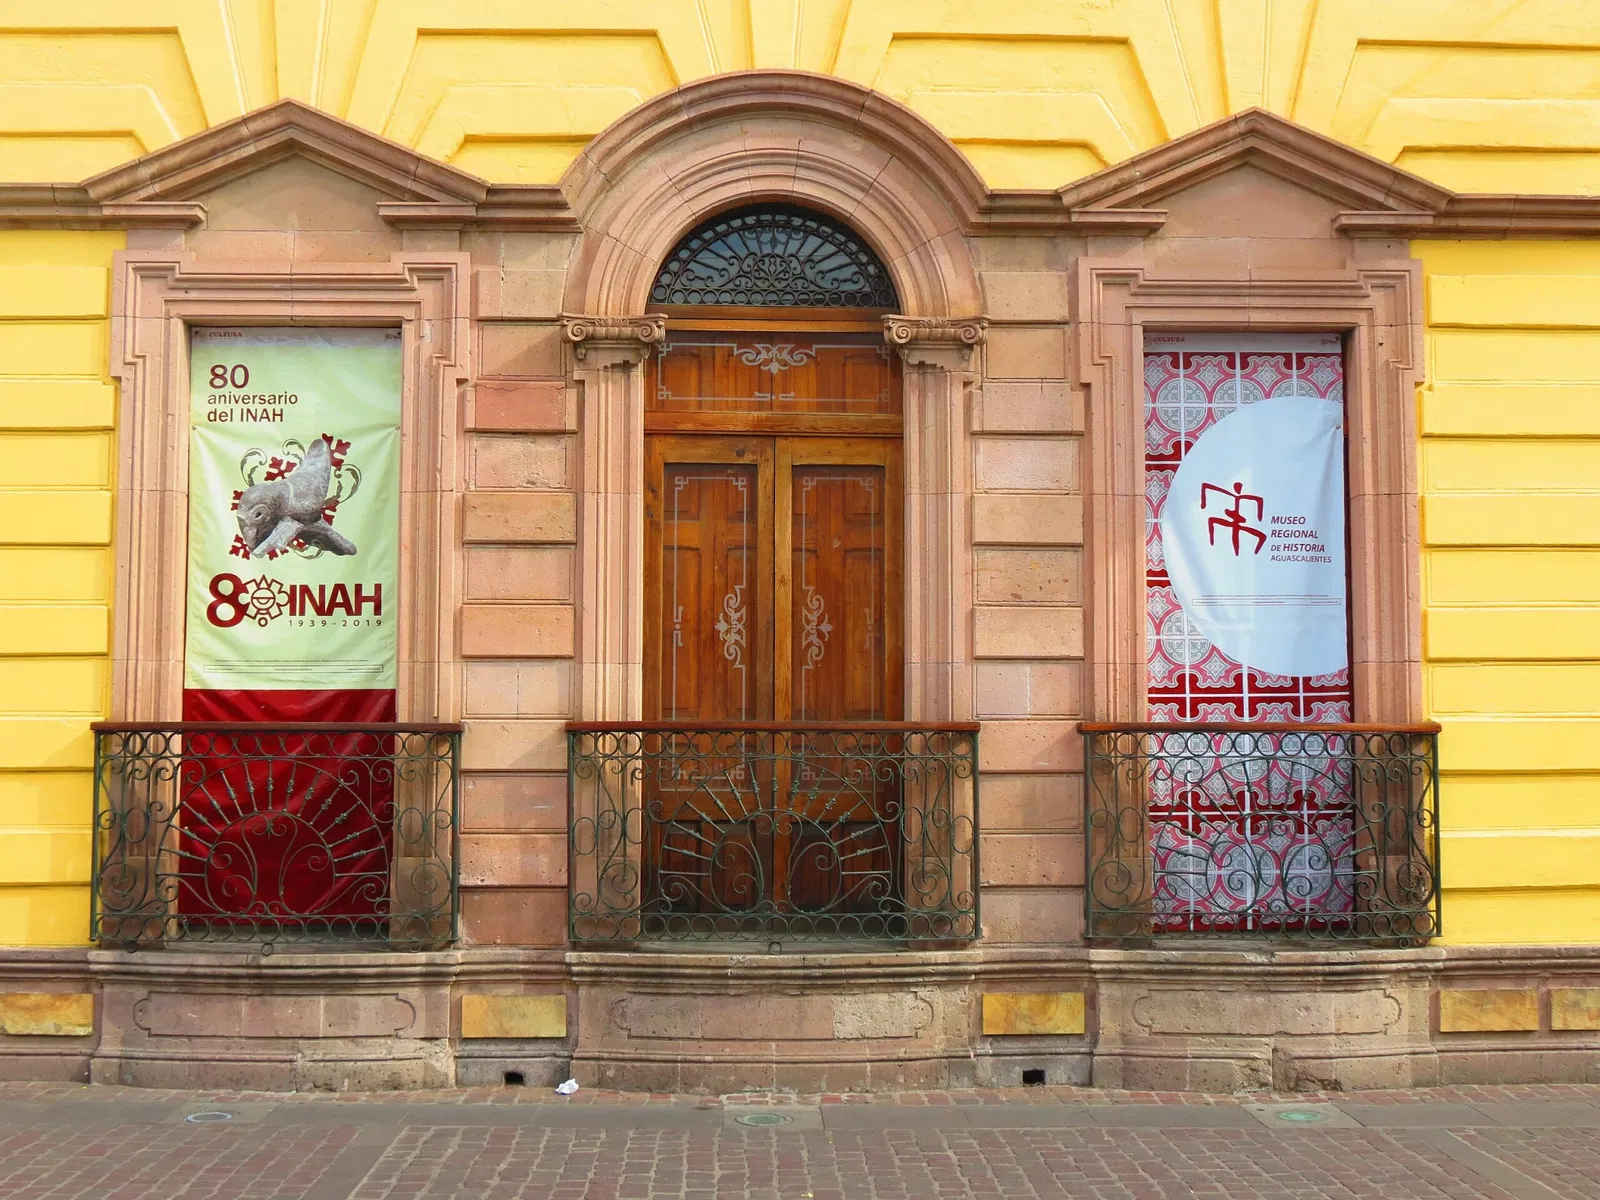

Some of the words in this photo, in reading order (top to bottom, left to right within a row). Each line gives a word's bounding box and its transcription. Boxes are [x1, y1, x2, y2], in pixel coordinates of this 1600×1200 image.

[208, 363, 250, 389] 80
[207, 391, 299, 405] aniversario
[207, 407, 234, 423] del
[240, 407, 284, 423] INAH
[1270, 515, 1306, 525] MUSEO
[1270, 529, 1319, 539] REGIONAL
[1270, 544, 1281, 552] DE
[1283, 543, 1325, 553] HISTORIA
[1270, 554, 1332, 564] AGUASCALIENTES
[288, 583, 383, 617] INAH
